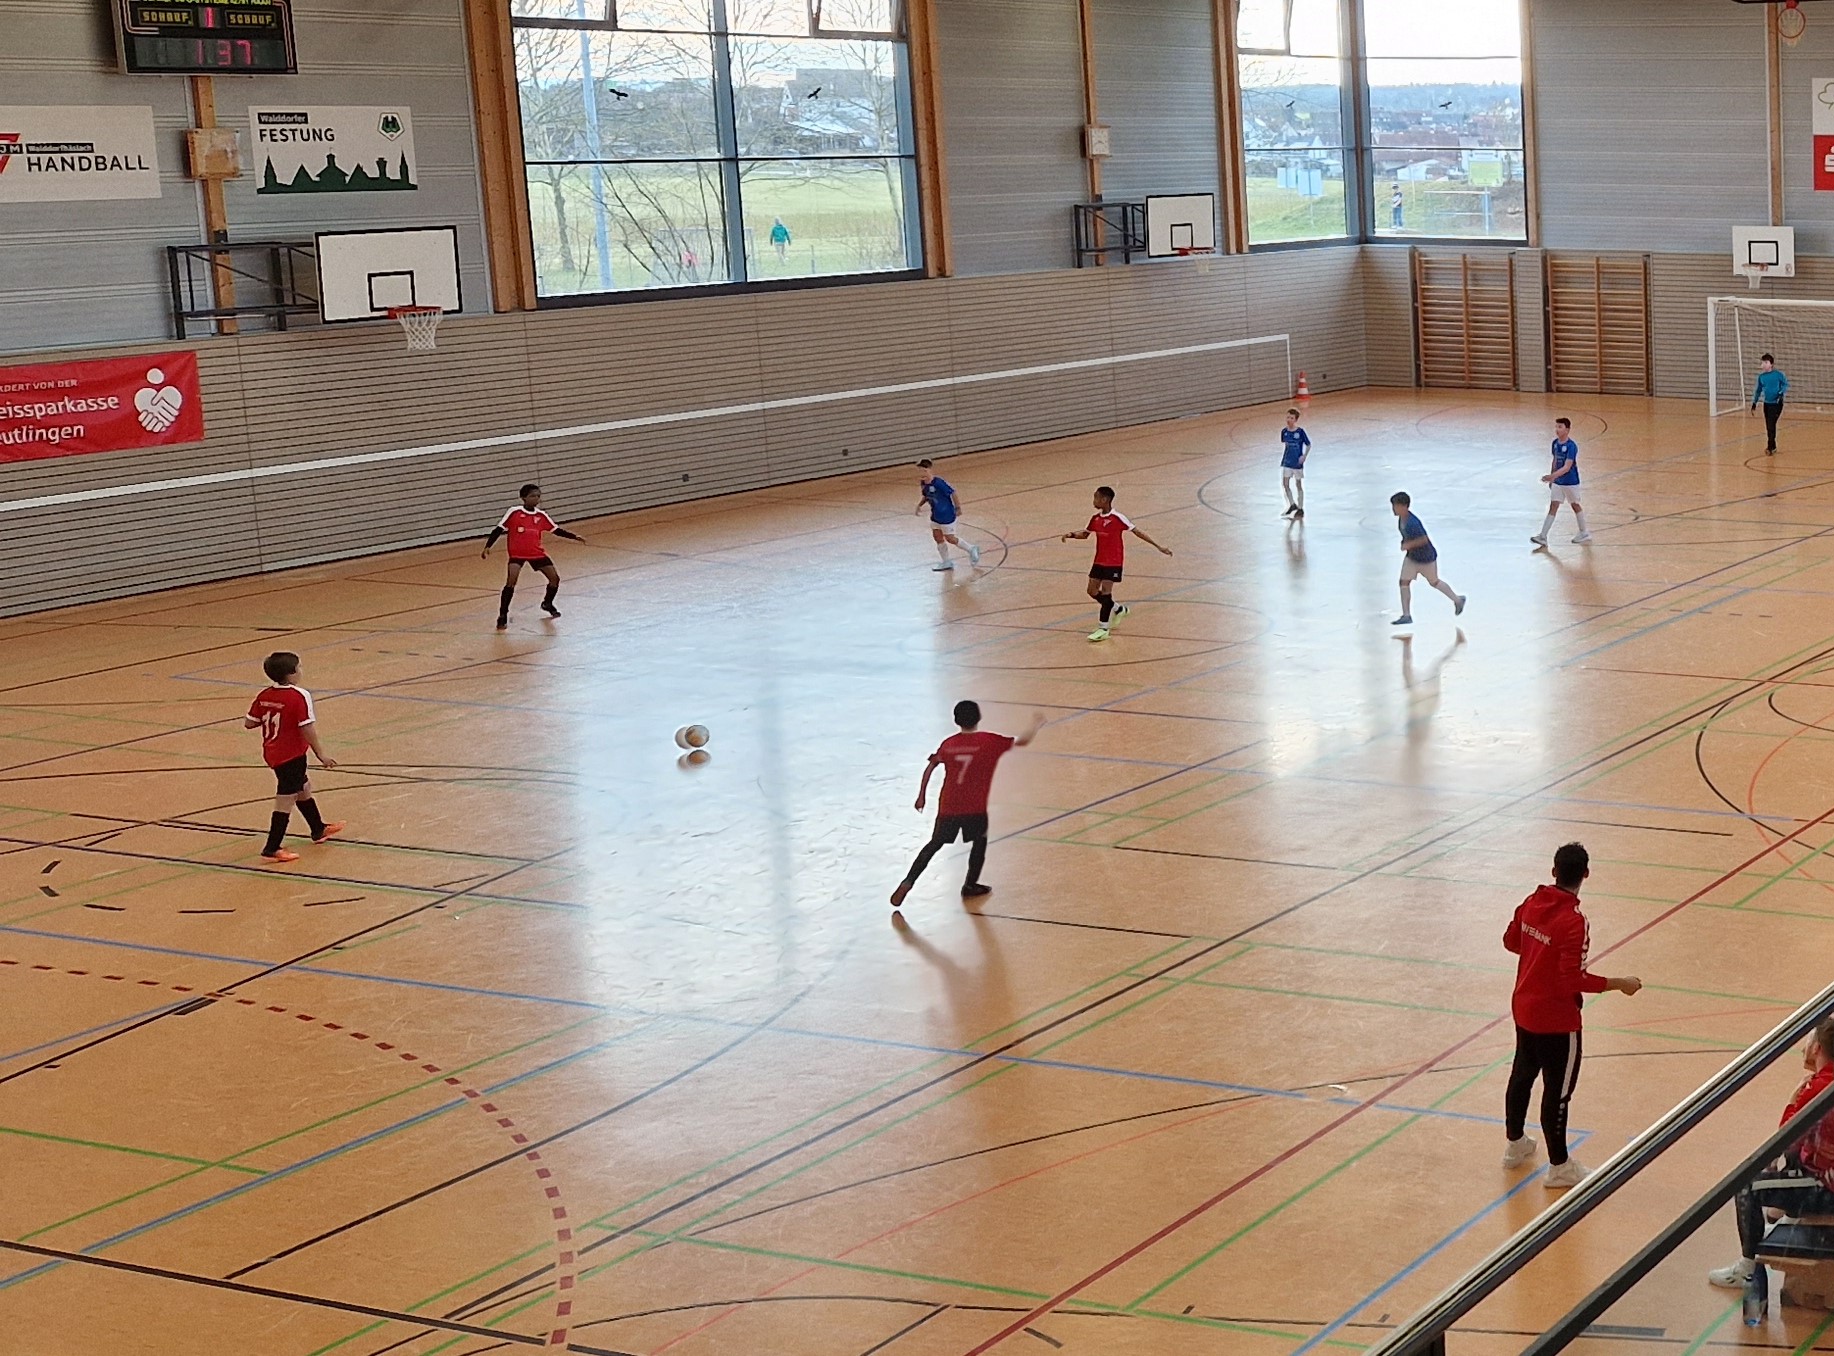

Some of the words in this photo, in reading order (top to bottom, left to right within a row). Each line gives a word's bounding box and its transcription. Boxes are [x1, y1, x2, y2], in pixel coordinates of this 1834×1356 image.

[260, 113, 307, 122] Walddorfer
[259, 128, 335, 142] FESTUNG
[27, 154, 150, 172] HANDBALL
[32, 380, 55, 390] VON
[57, 378, 78, 388] DER
[262, 711, 281, 740] 11
[955, 754, 973, 785] 7
